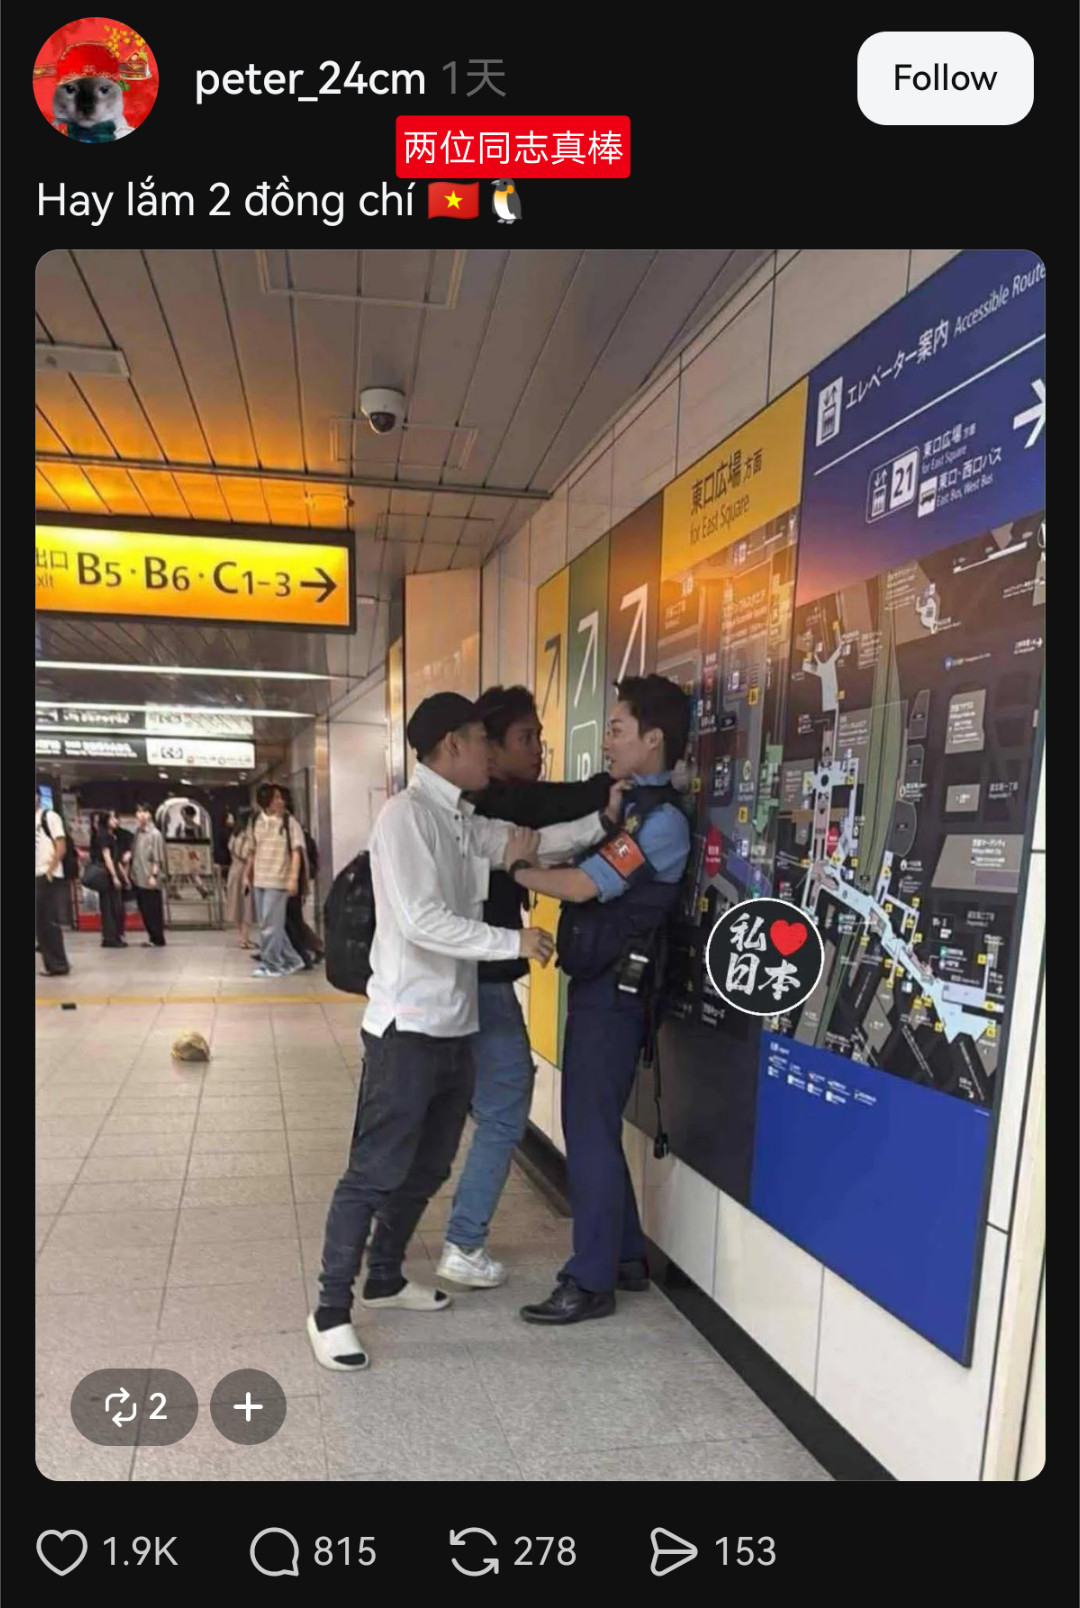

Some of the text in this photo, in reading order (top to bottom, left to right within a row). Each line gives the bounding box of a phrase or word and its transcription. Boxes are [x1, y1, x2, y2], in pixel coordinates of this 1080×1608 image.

[845, 319, 950, 410] エレベーター案内
[953, 283, 1010, 338] Accessible
[690, 448, 742, 517] 東口広場
[893, 460, 915, 500] 21
[702, 509, 719, 539] East
[719, 493, 750, 532] Square
[77, 551, 123, 588] B5
[144, 555, 190, 592] B6
[212, 560, 292, 598] C1-3
